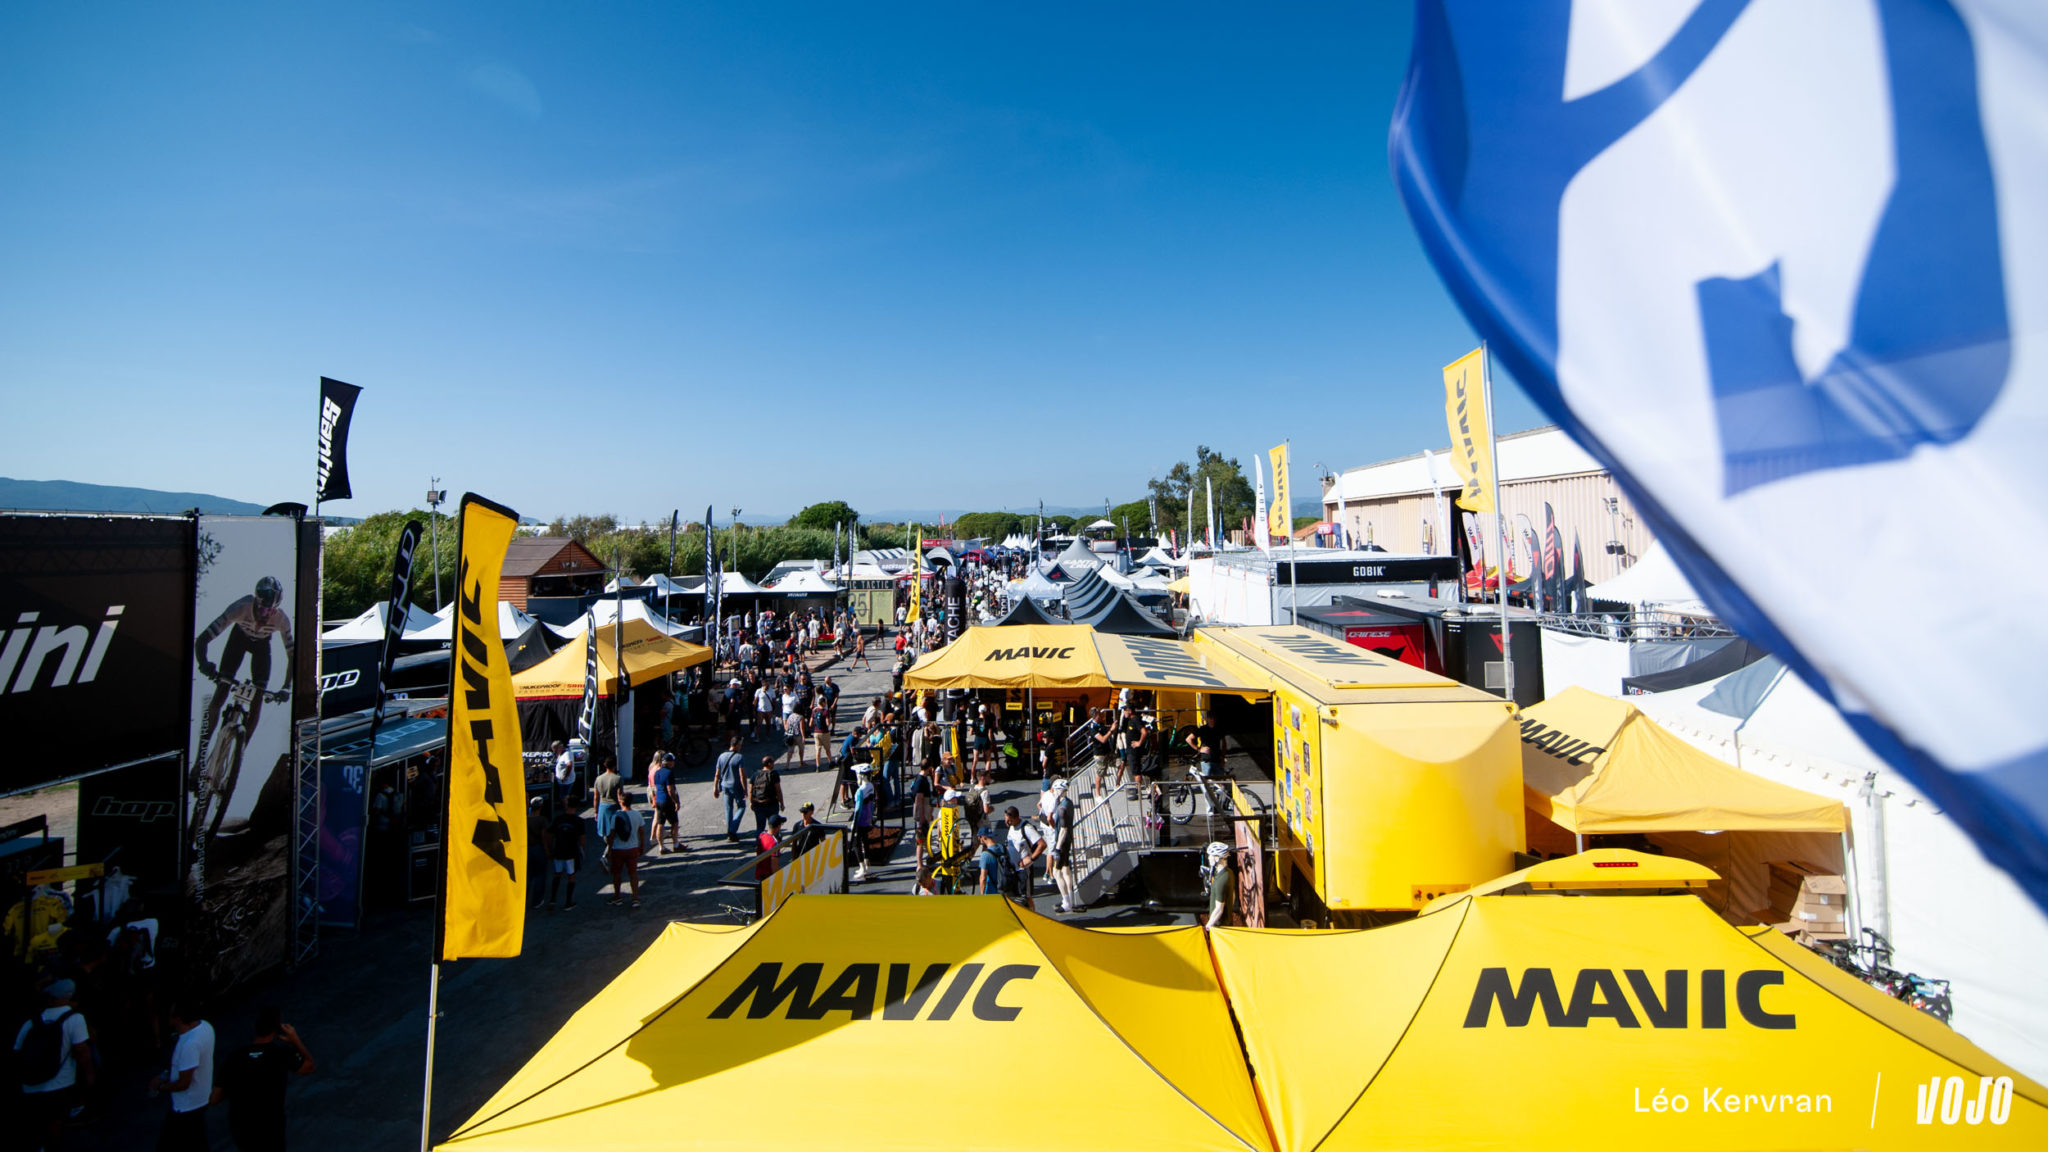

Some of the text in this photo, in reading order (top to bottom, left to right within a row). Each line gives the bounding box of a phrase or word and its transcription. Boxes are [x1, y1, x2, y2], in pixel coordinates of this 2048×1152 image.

[861, 580, 889, 589] TACTIC
[1352, 566, 1384, 577] GOBIK
[0, 604, 126, 695] ini
[985, 646, 1076, 662] MAVIC
[1520, 719, 1607, 767] MAVIC
[761, 830, 843, 918] MAVIC
[709, 963, 1040, 1022] MAVIC
[1463, 967, 1797, 1030] MAVIC
